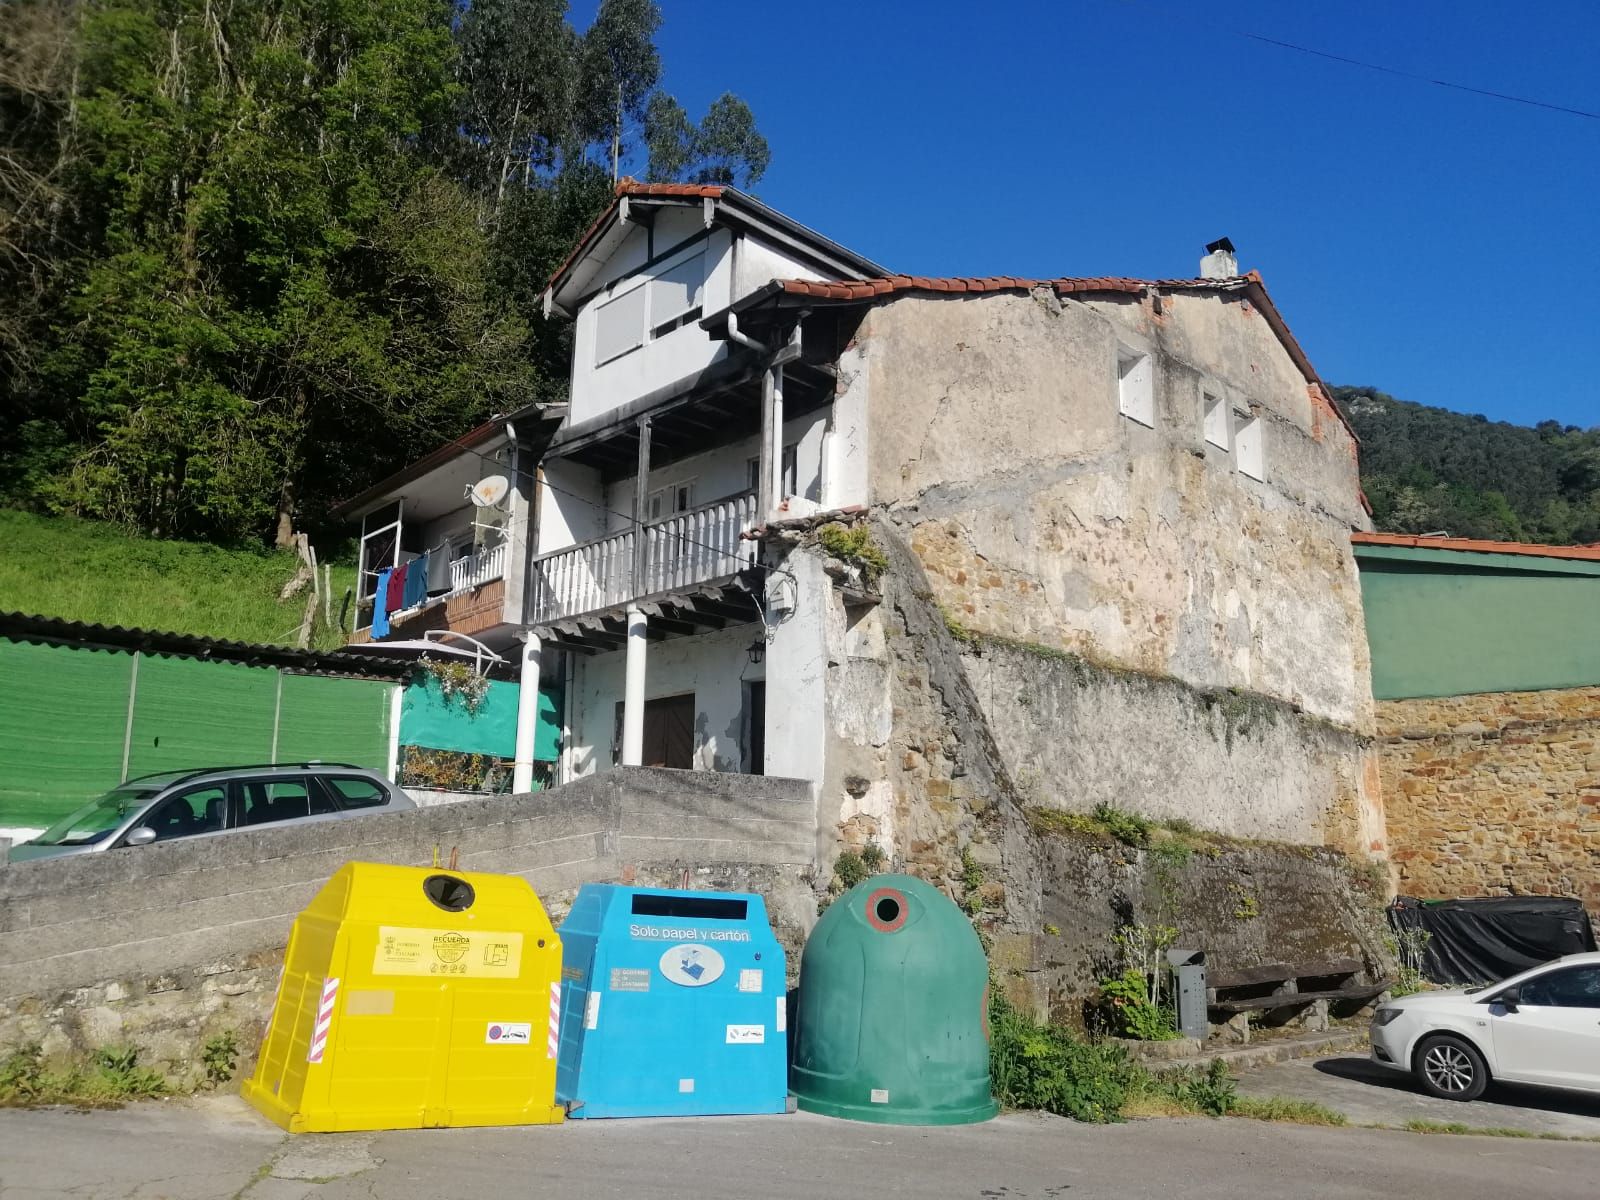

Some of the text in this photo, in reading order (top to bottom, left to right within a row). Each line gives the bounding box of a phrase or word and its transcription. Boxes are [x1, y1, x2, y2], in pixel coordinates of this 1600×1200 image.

[433, 935, 470, 944] RECUERDA
[630, 924, 749, 942] Solo papel y cartón
